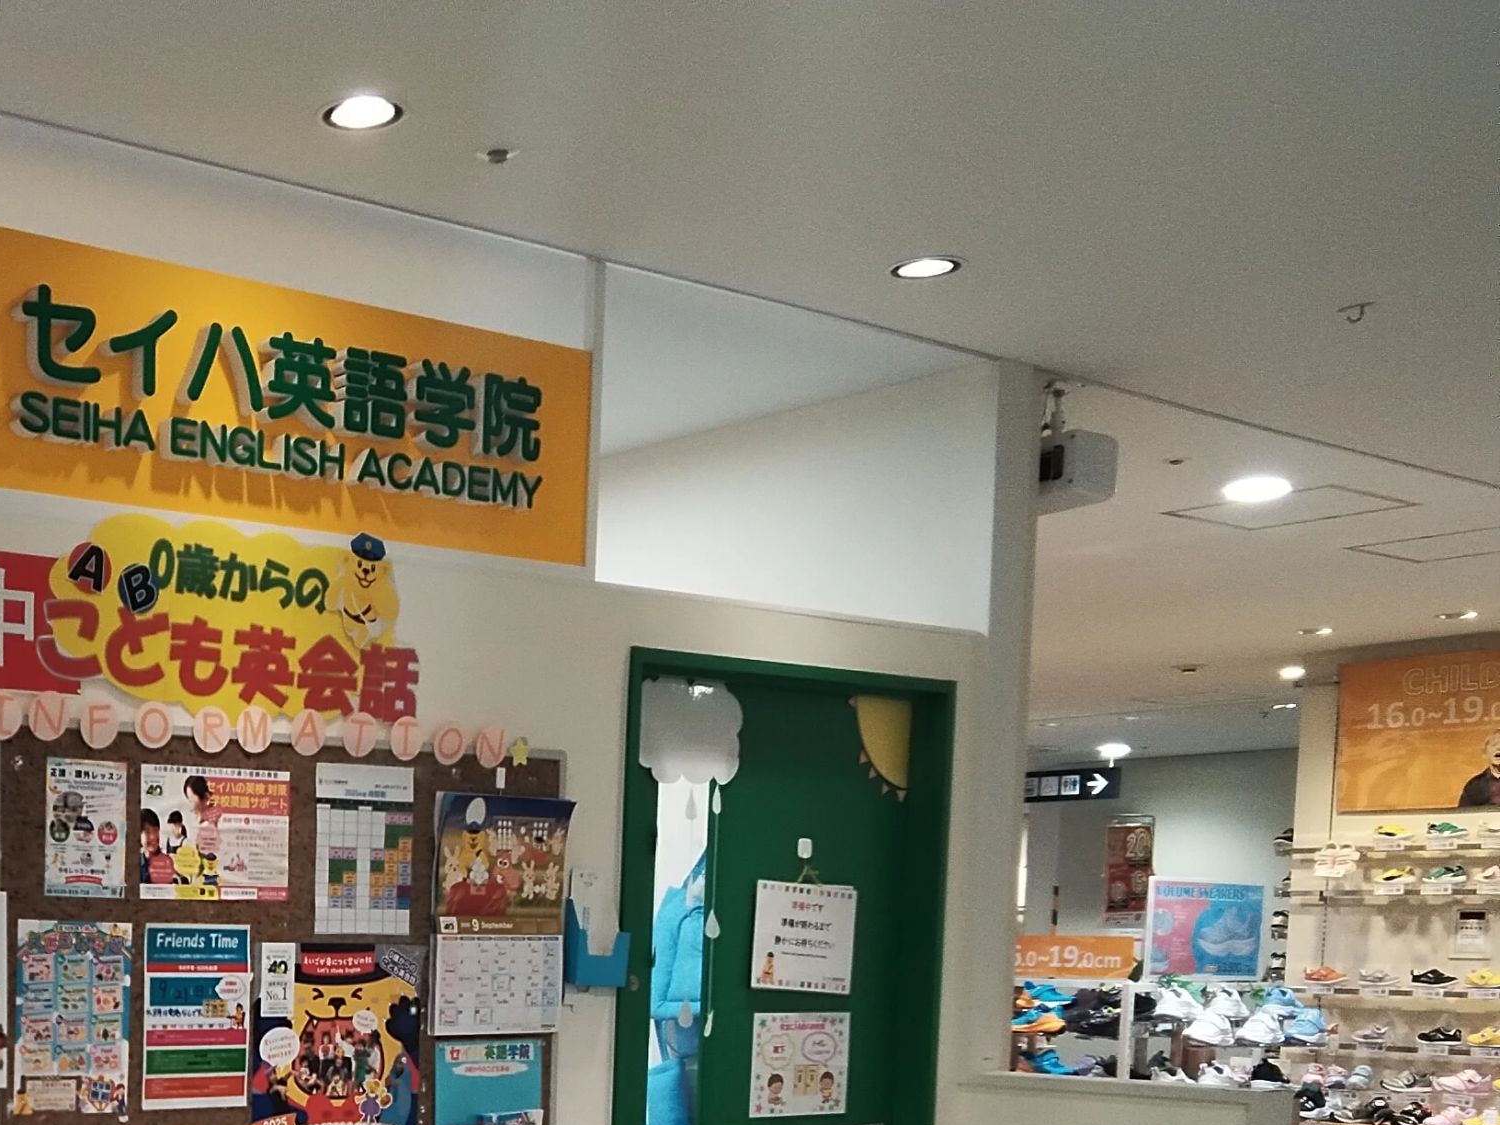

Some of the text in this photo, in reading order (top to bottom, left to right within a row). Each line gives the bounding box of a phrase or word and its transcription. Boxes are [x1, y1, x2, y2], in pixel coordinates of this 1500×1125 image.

[21, 282, 543, 463] セイハ英語学院
[18, 391, 544, 511] SEIHA ENGLISH ACADEMY
[149, 538, 330, 614] 0歳からの
[37, 599, 420, 722] こども英会話
[156, 932, 240, 949] Friends Time
[1156, 886, 1197, 898] VOLUME
